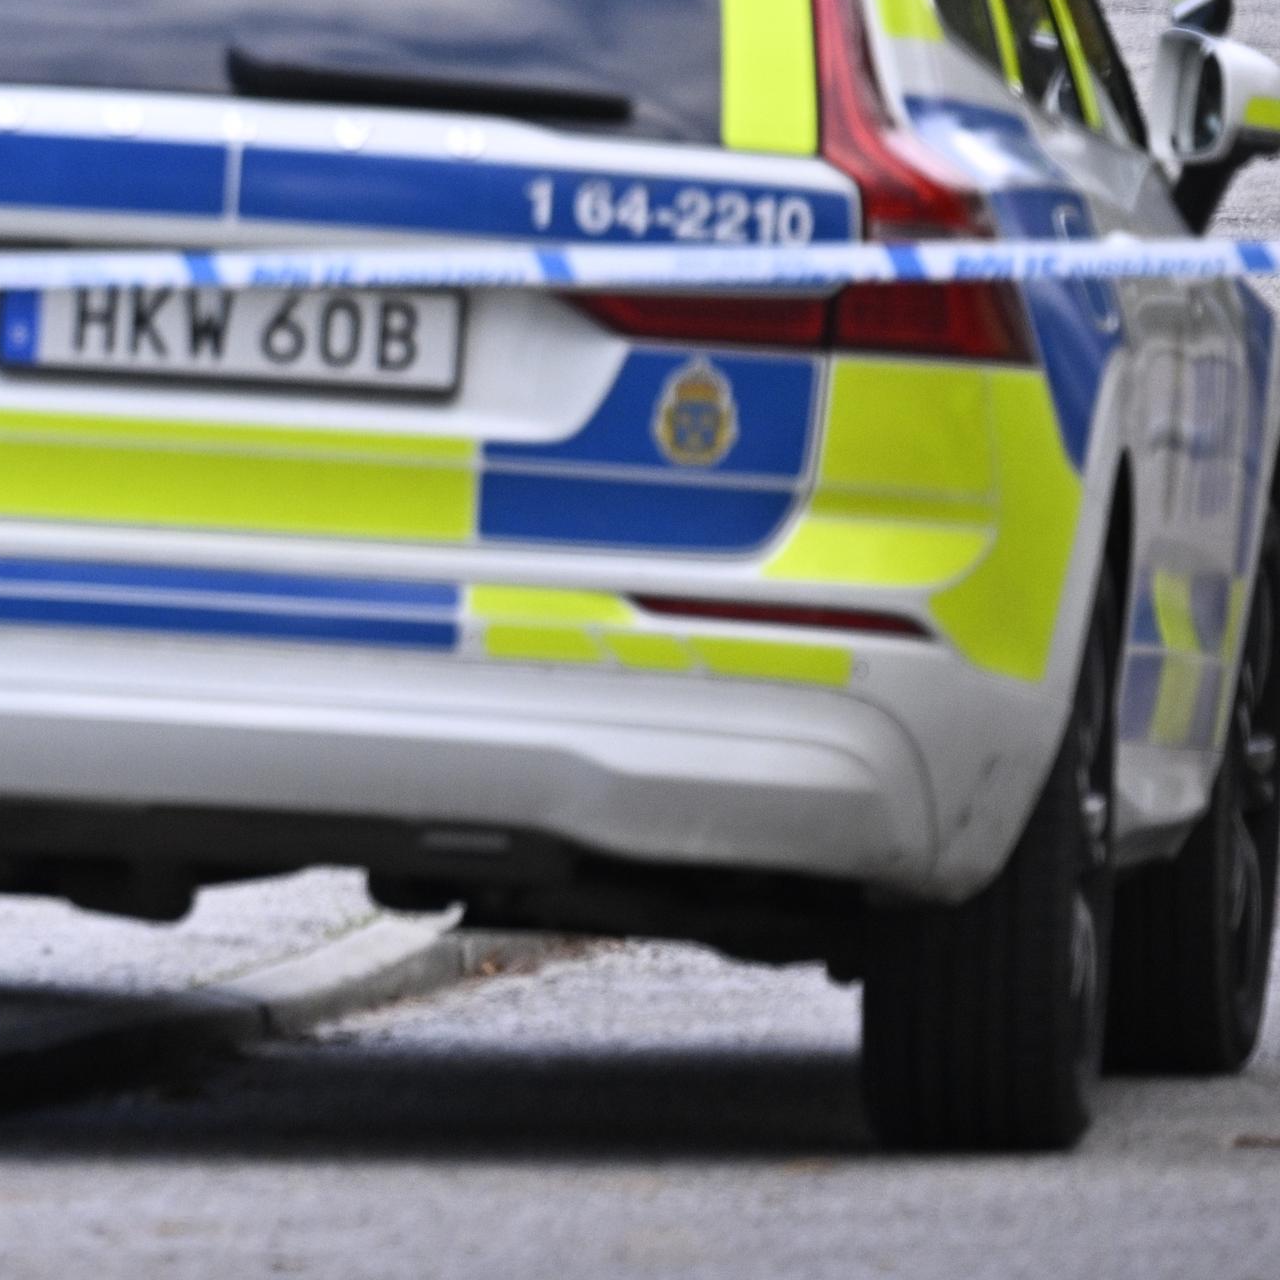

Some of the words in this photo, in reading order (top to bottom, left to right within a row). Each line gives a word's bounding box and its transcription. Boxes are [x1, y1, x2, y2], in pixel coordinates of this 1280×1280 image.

[528, 177, 554, 231] 1
[573, 180, 814, 247] 64-2210
[73, 284, 233, 360] HKW
[260, 285, 419, 372] 60B
